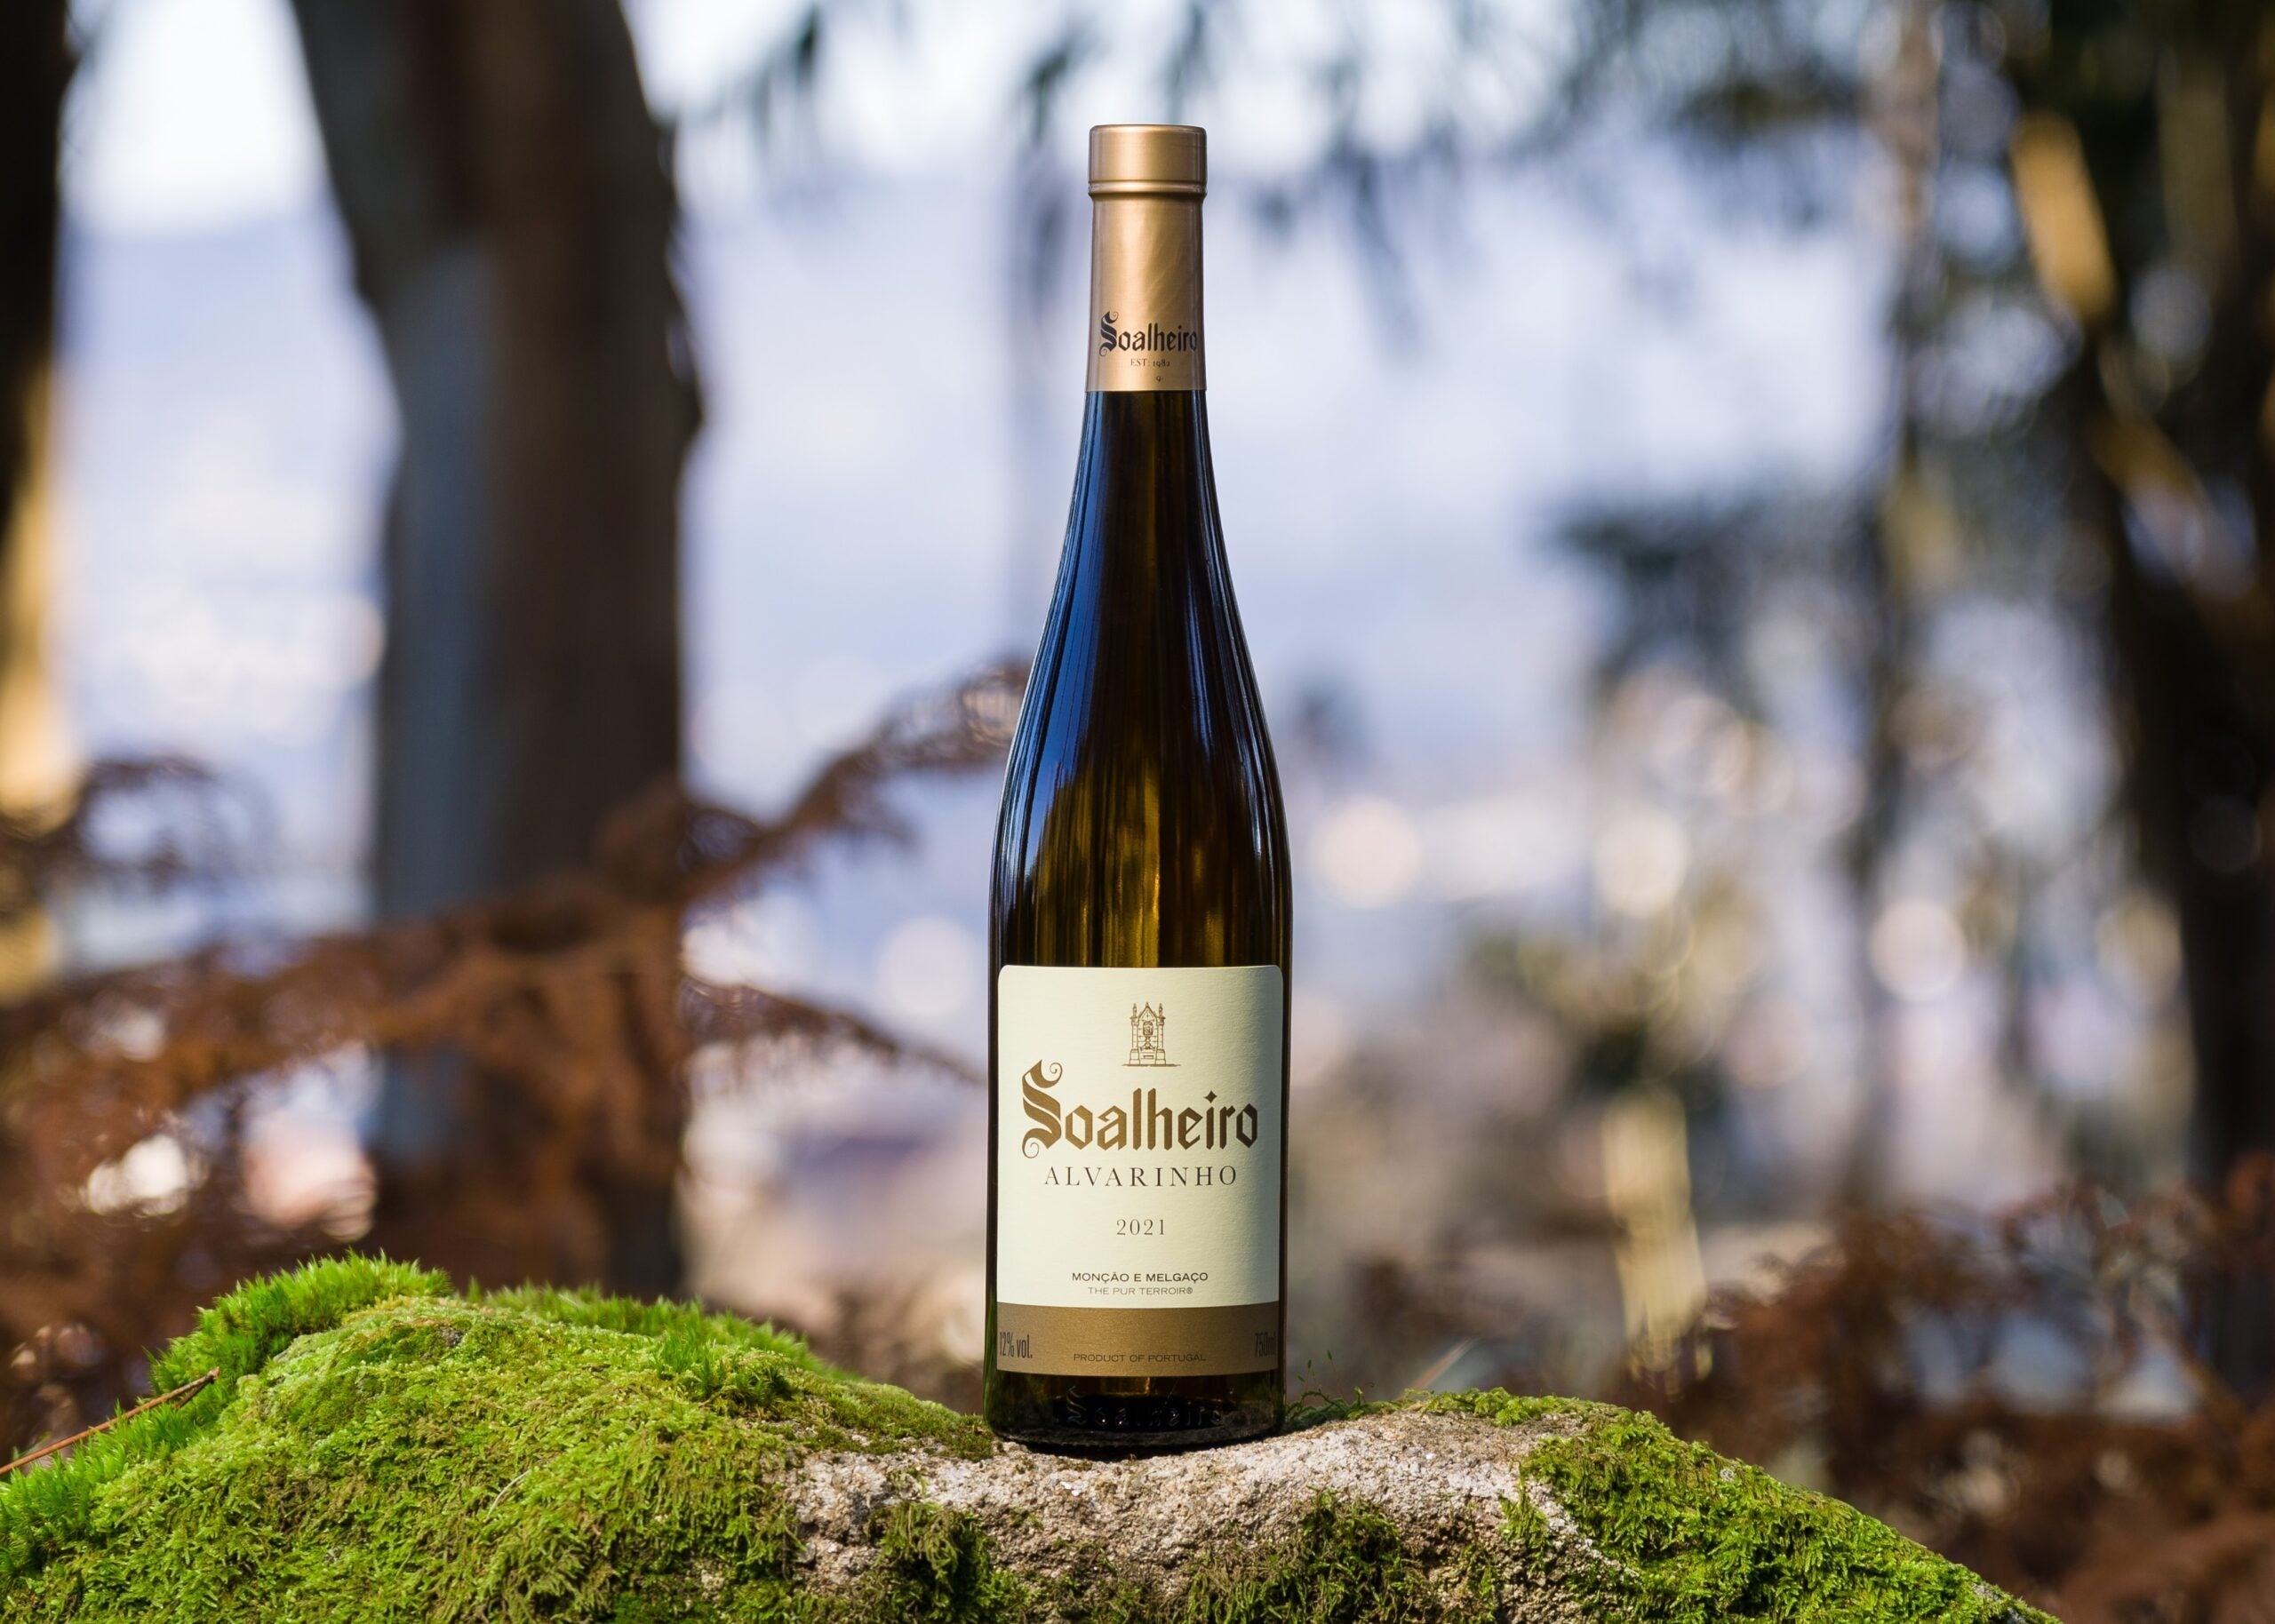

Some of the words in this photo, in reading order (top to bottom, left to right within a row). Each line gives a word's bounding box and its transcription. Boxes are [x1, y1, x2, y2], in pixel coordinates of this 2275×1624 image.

[1099, 311, 1197, 356] Soalheiro
[1022, 1059, 1257, 1158] Soalheiro
[1044, 1166, 1237, 1187] ALVARINHO
[1116, 1218, 1165, 1236] 2021
[1072, 1271, 1130, 1284] MONÇÃO
[1134, 1273, 1142, 1282] E
[1145, 1272, 1209, 1284] MELGAÇO
[1088, 1286, 1110, 1295] THE
[1000, 1331, 1015, 1357] 12%
[1016, 1334, 1034, 1358] vol.
[1074, 1353, 1126, 1363] PRODUCT
[1130, 1354, 1145, 1363] OF
[1148, 1353, 1207, 1363] PORTUGAL
